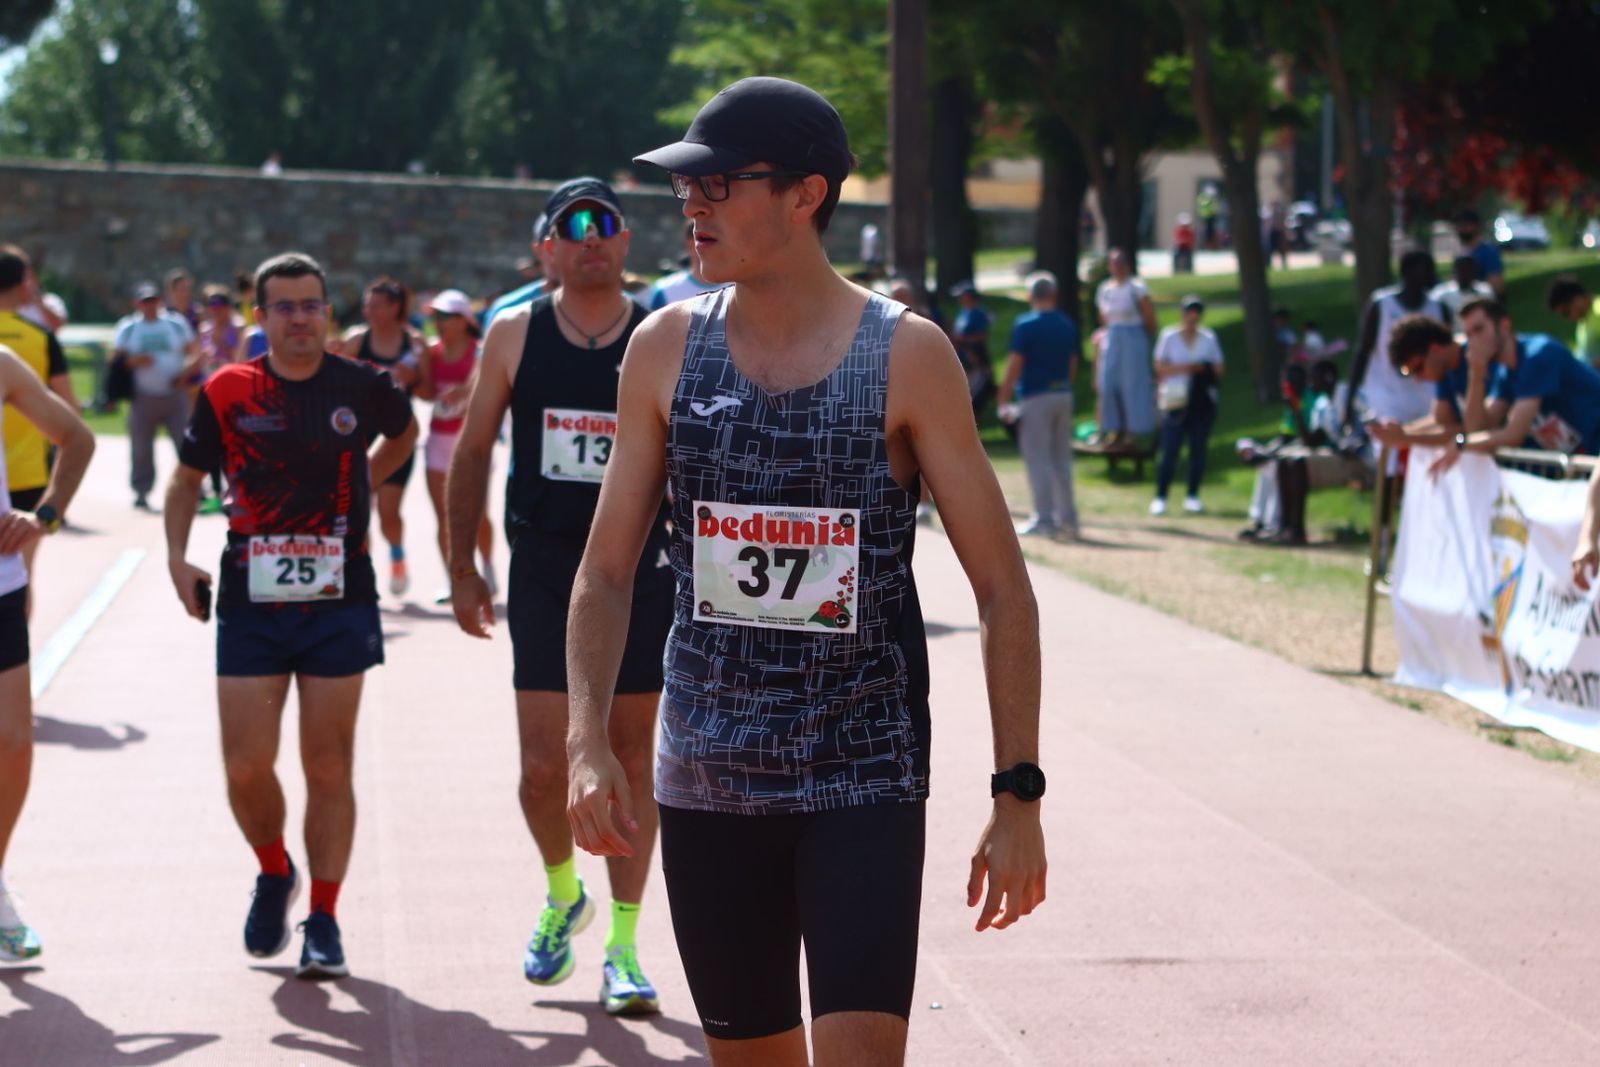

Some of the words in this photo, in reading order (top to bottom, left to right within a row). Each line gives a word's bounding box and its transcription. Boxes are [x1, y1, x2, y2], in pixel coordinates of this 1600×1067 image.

[546, 413, 617, 435] bedun
[572, 434, 613, 466] 13
[698, 512, 855, 546] bedunia
[251, 540, 341, 557] bedunia
[275, 557, 317, 585] 25
[737, 545, 810, 601] 37
